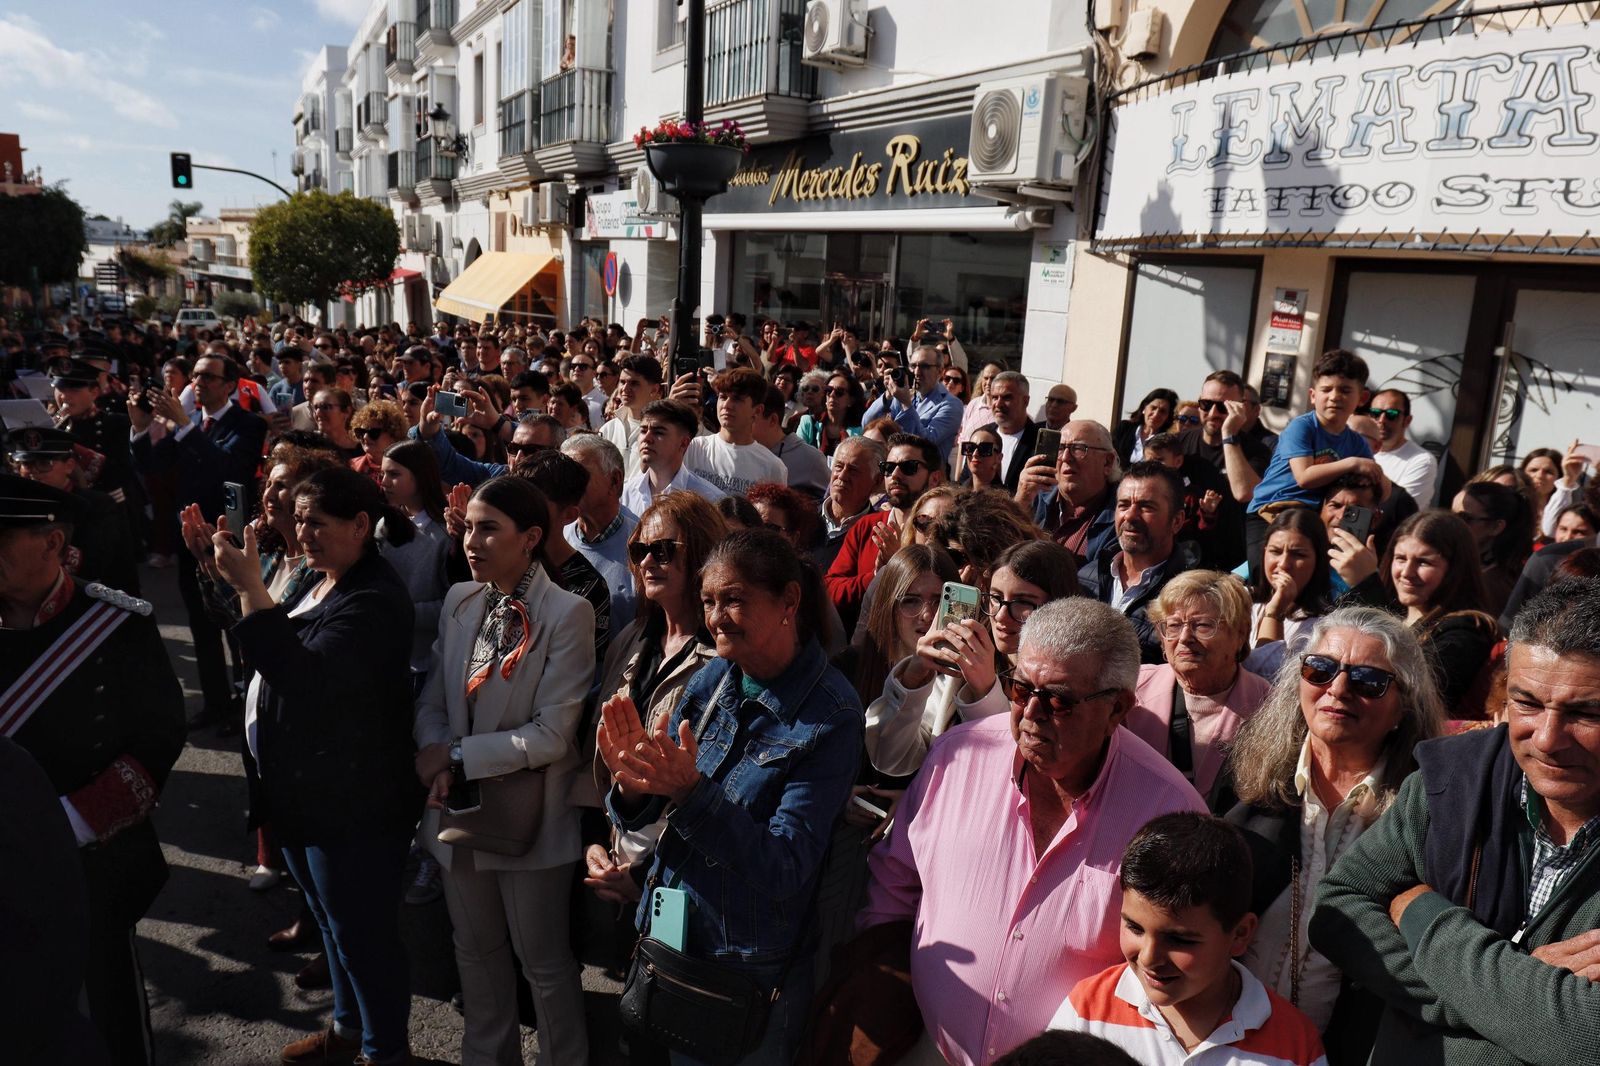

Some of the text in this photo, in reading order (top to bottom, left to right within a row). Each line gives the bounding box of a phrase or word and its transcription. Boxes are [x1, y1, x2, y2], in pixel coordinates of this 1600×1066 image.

[1166, 44, 1600, 175] LEMATA
[768, 150, 882, 206] Mercedes
[886, 134, 970, 197] Ruiz
[1204, 181, 1416, 214] TATTOO
